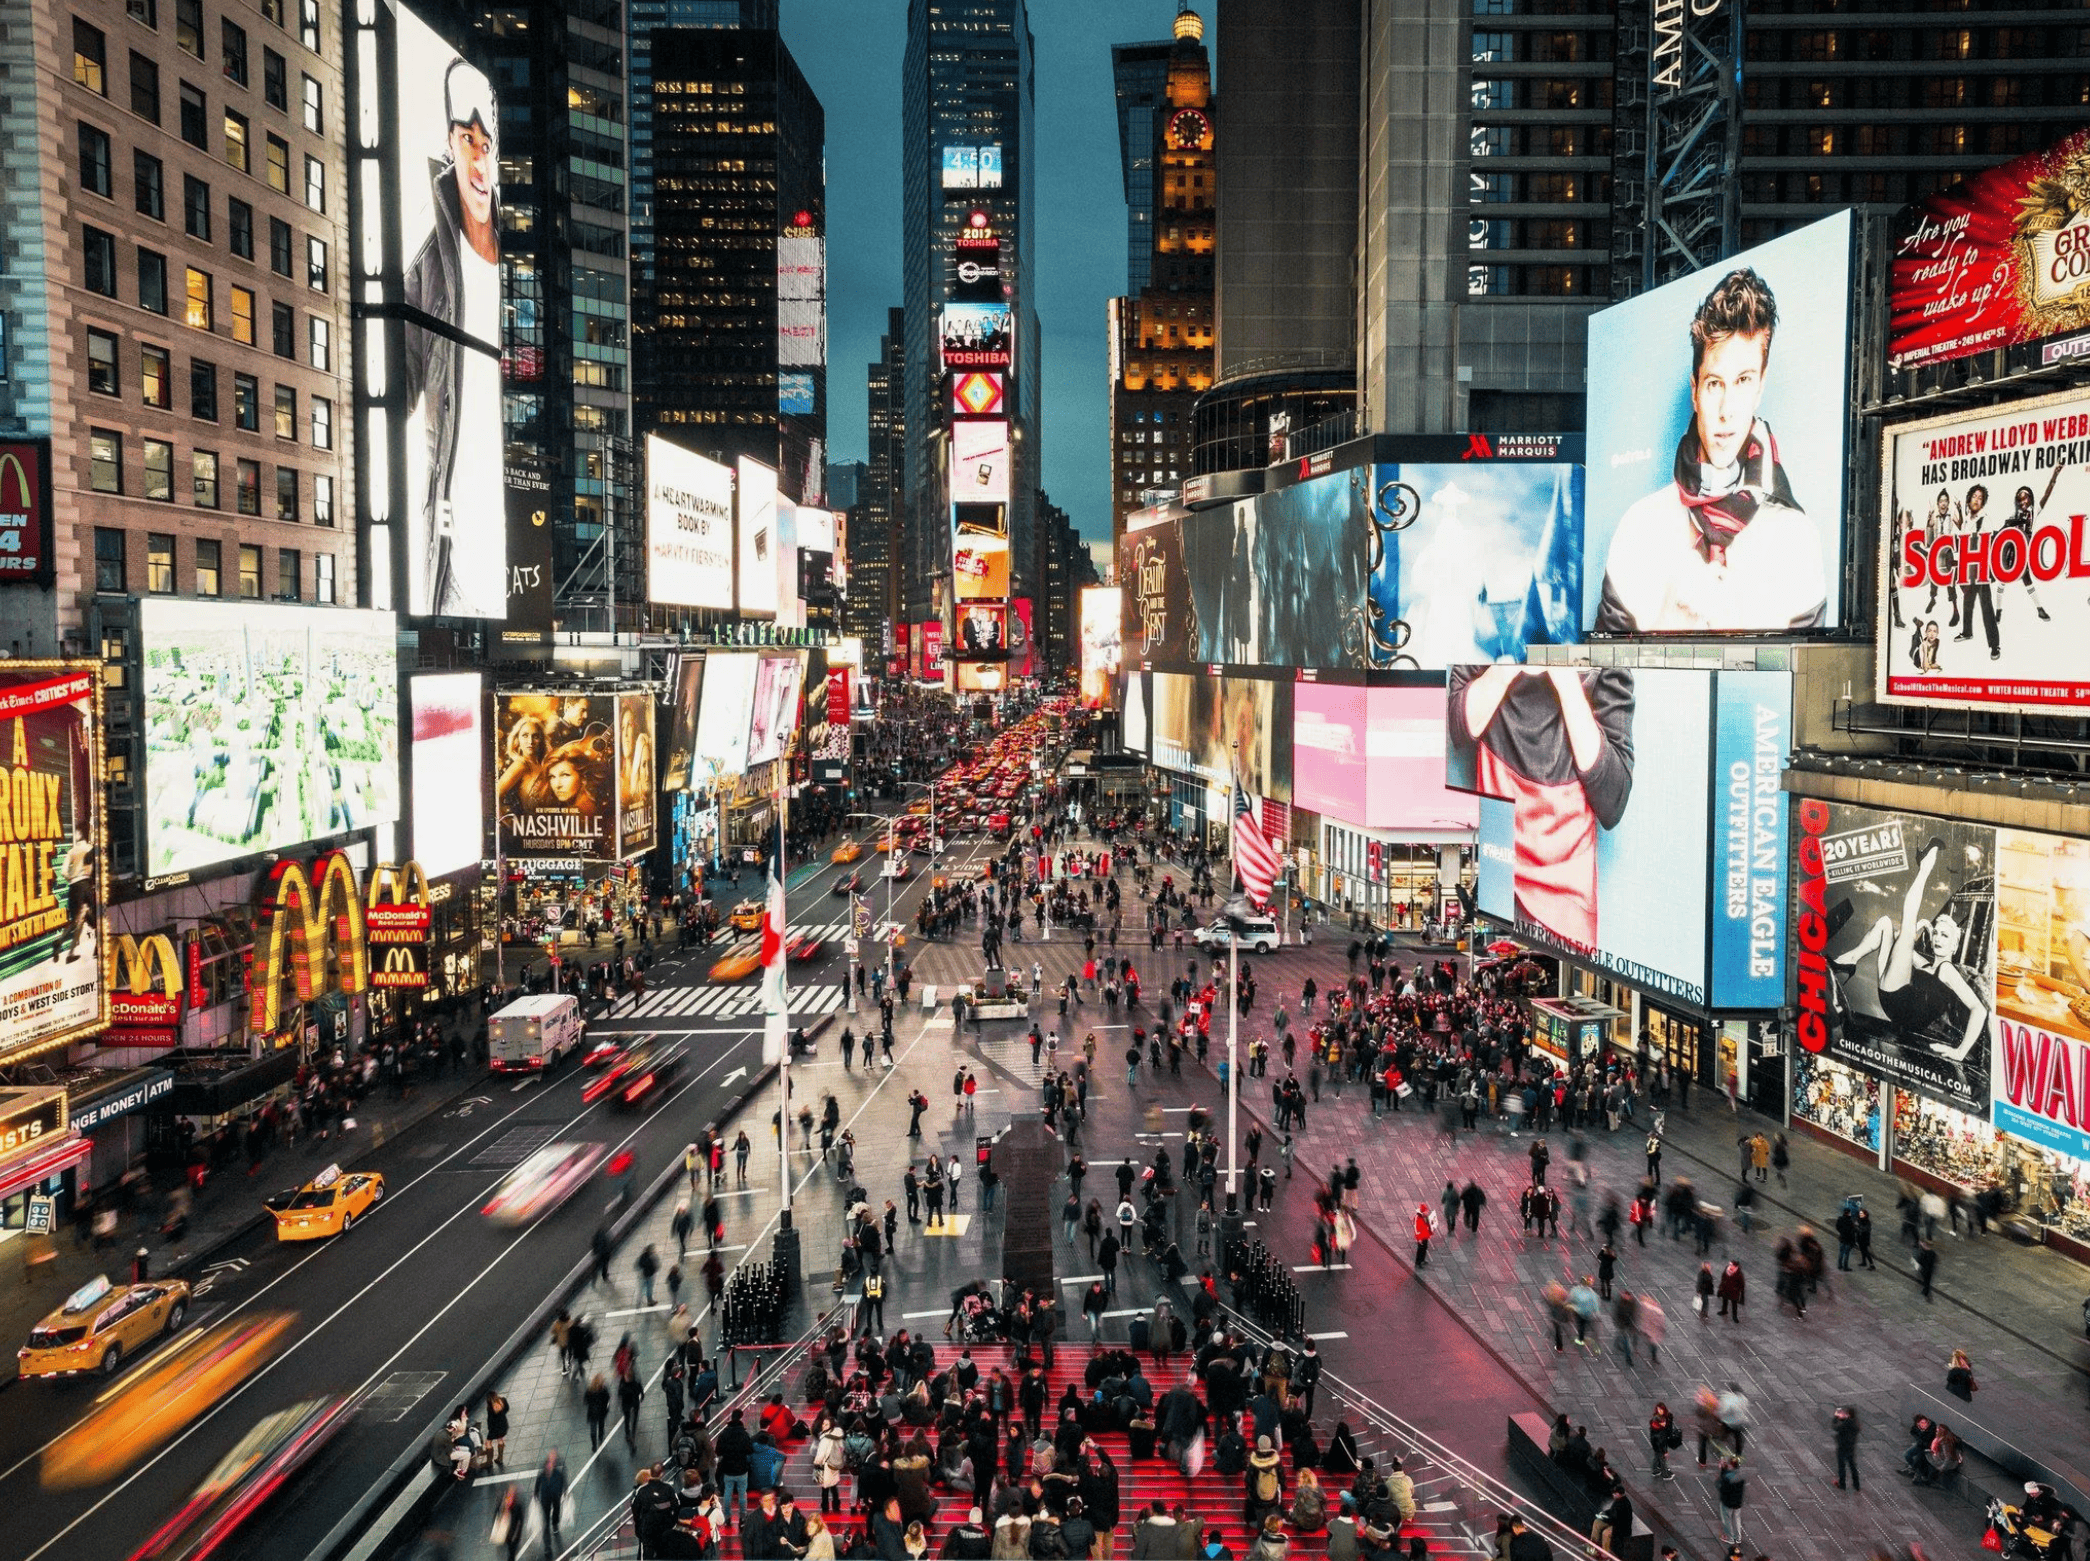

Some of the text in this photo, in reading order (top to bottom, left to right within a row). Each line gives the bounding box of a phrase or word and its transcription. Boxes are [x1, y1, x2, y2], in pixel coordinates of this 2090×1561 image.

[956, 239, 998, 247] TOSHIBA
[963, 228, 992, 239] 2017
[1898, 212, 1971, 258] Are you
[1912, 232, 1979, 294] ready to
[1923, 263, 2010, 324] wake up?
[945, 351, 1010, 364] TOSHIBA
[1903, 346, 1931, 362] IMPERIAL
[1931, 339, 1959, 354] THEATRE
[1498, 435, 1563, 445] MARRIOTT
[1991, 422, 2038, 451] LLOYD
[2043, 413, 2090, 444] WEBB
[1310, 450, 1334, 464] MARRIOTT
[1498, 447, 1555, 456] MARQUIS
[510, 467, 527, 479] BACK
[527, 471, 541, 481] AND
[1921, 457, 1948, 486] HAS
[1951, 448, 2031, 482] BROADWAY
[513, 478, 531, 488] THAN
[662, 485, 730, 521] HEARTWARMING
[677, 511, 711, 536] BOOK BY
[1903, 513, 2090, 589] SCHOOL
[1135, 543, 1166, 601] BEAUTY
[1139, 597, 1167, 656] BEAST
[70, 677, 90, 694] PICK
[1987, 685, 2012, 695] WINTER
[2039, 687, 2069, 698] THEATRE
[13, 714, 29, 766] A
[512, 815, 604, 837] NASHVILLE
[621, 806, 652, 836] NASHVILLE
[522, 839, 595, 850] THURSDAYS 9PM CMT
[1727, 760, 1750, 919] OUTFITTERS
[1750, 703, 1780, 977] AMERICAN EAGLE
[1846, 827, 1901, 856] YEARS
[519, 859, 584, 870] LUGGAGE
[367, 910, 428, 920] McDonald's
[1797, 798, 1829, 1053] CHICAGO
[1513, 919, 1704, 1004] AMERICAN EAGLE OUTFITTERS
[9, 978, 63, 1005] COMBINATION OF
[20, 1003, 27, 1015] &
[28, 995, 51, 1012] WEST
[52, 989, 69, 1005] SIDE
[111, 1003, 177, 1014] cDonald's
[101, 1033, 172, 1042] OPEN 24 HOURS
[1838, 1037, 1973, 1096] CHICAGOTHEMUSICAL.COM
[149, 1077, 173, 1098] ATM
[70, 1090, 144, 1131] NGE MONEY
